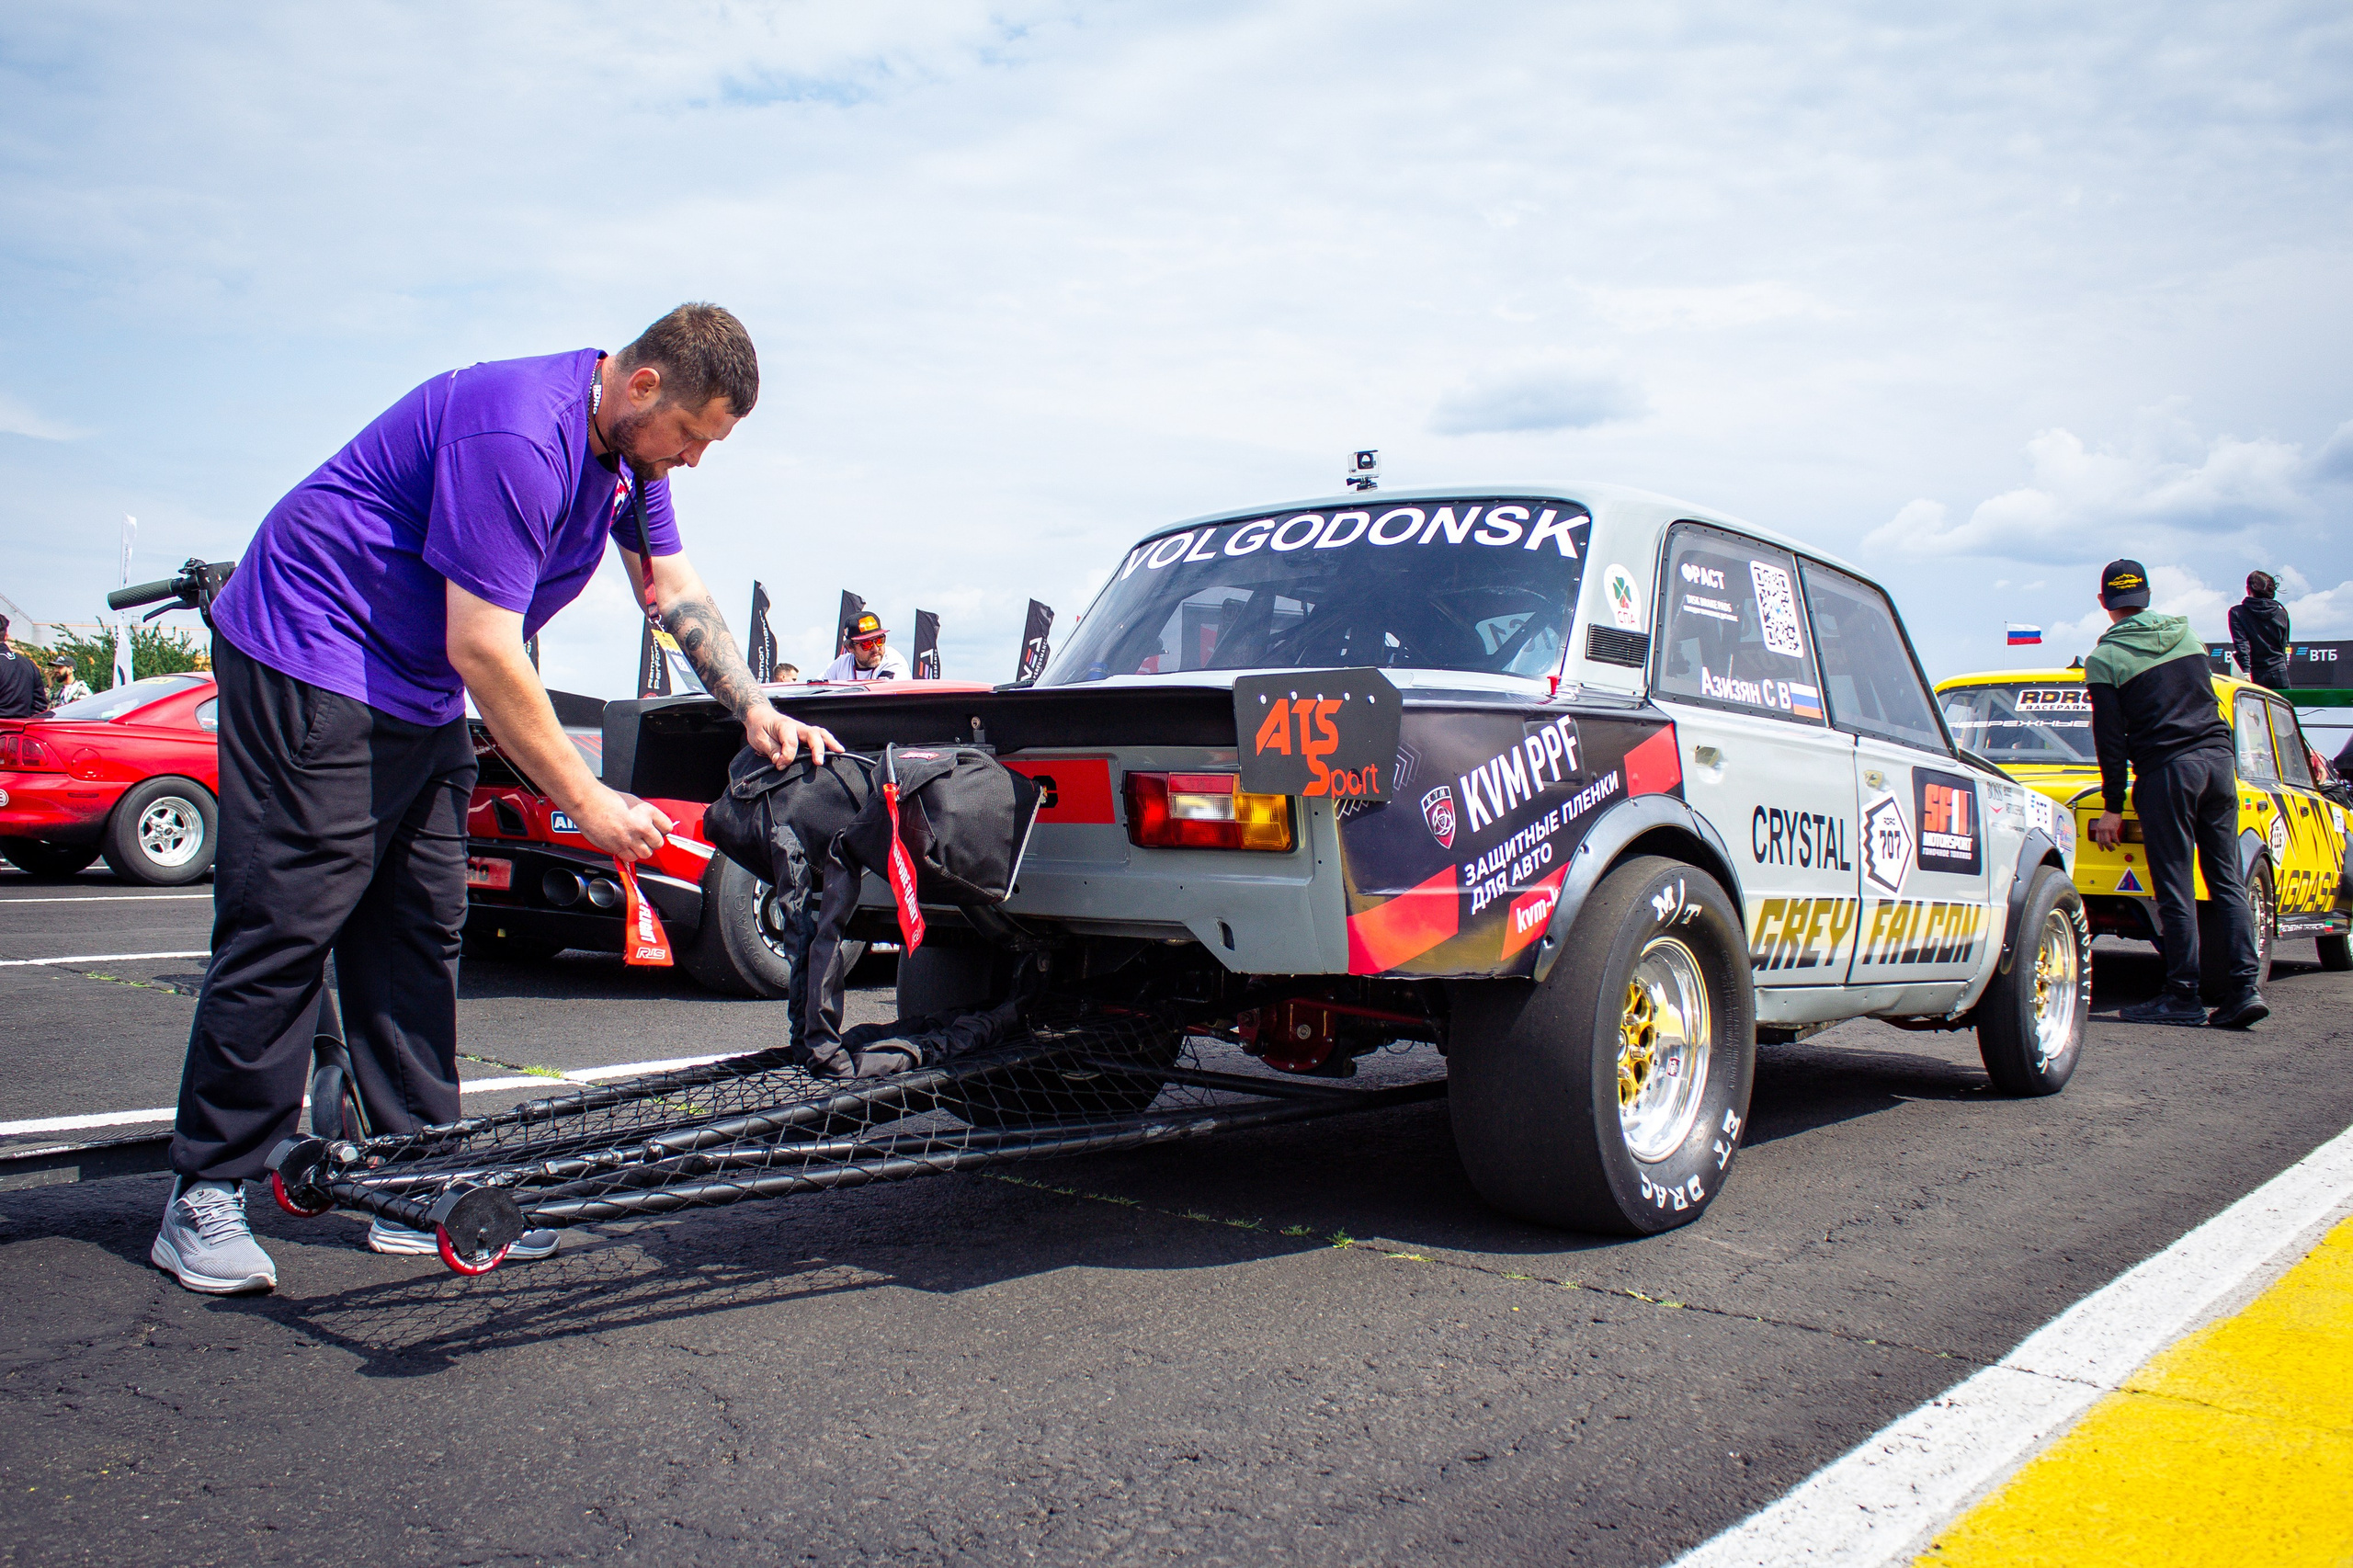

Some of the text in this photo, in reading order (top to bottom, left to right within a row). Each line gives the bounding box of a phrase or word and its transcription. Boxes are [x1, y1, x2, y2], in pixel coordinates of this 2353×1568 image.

[1120, 506, 1590, 581] VOLGODONSK
[1680, 562, 1725, 590] ФРАСТ
[1618, 610, 1636, 624] СПА
[2309, 649, 2337, 662] ВТБ
[1256, 698, 1343, 756] ATS
[1947, 720, 2090, 729] АБЕРЕЖНЫЕ
[1302, 752, 1379, 800] Sport
[1427, 789, 1446, 804] KVM
[1459, 715, 1579, 833] KVM PPF
[1463, 770, 1620, 887] ЗАЩИТНЫЕ ПЛЕНКИ
[1752, 805, 1851, 872] CRYSTAL
[1879, 830, 1901, 859] 707
[1922, 831, 1973, 851] MOTORSPORT
[1471, 843, 1553, 915] ДЛЯ АВТО
[635, 947, 665, 960] RJS
[1752, 898, 1983, 972] GREY FALCON
[1713, 1108, 1742, 1170] ET
